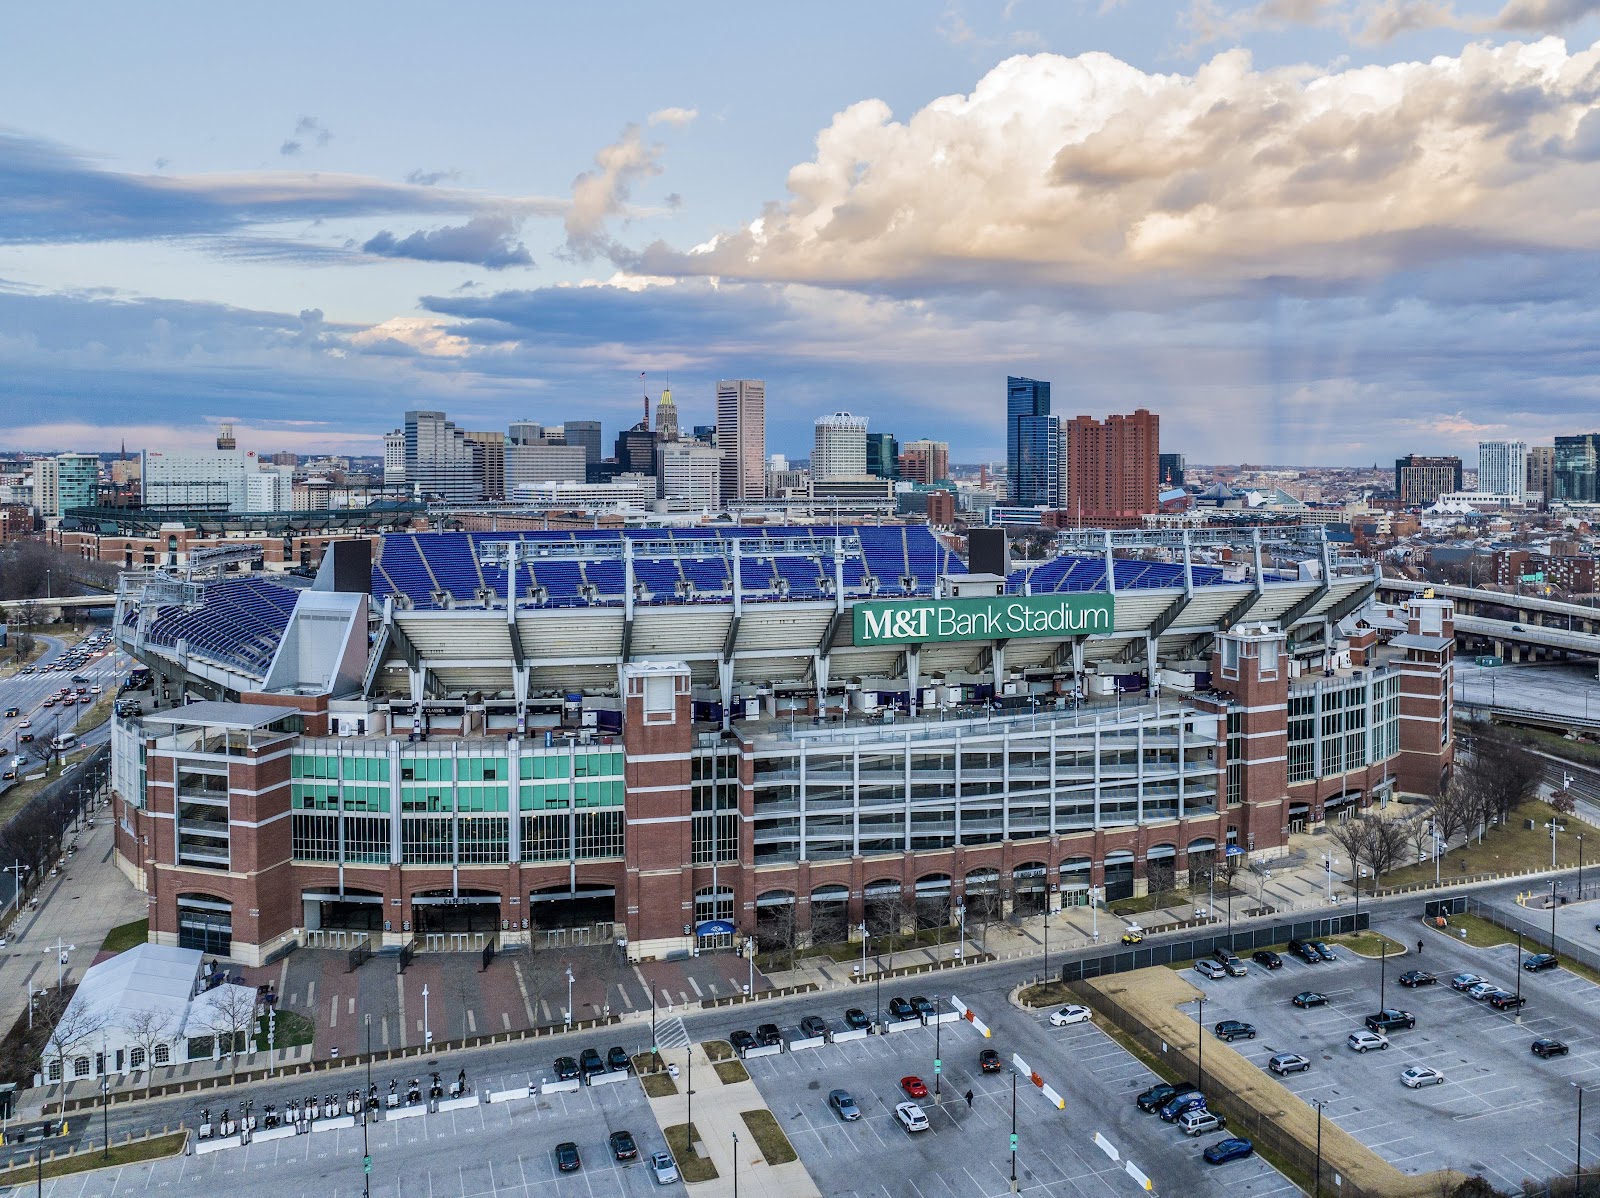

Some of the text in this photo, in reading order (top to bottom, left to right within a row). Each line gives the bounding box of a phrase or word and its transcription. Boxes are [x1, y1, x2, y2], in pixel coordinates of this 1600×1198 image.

[862, 602, 1109, 640] M&T Bank Stadium
